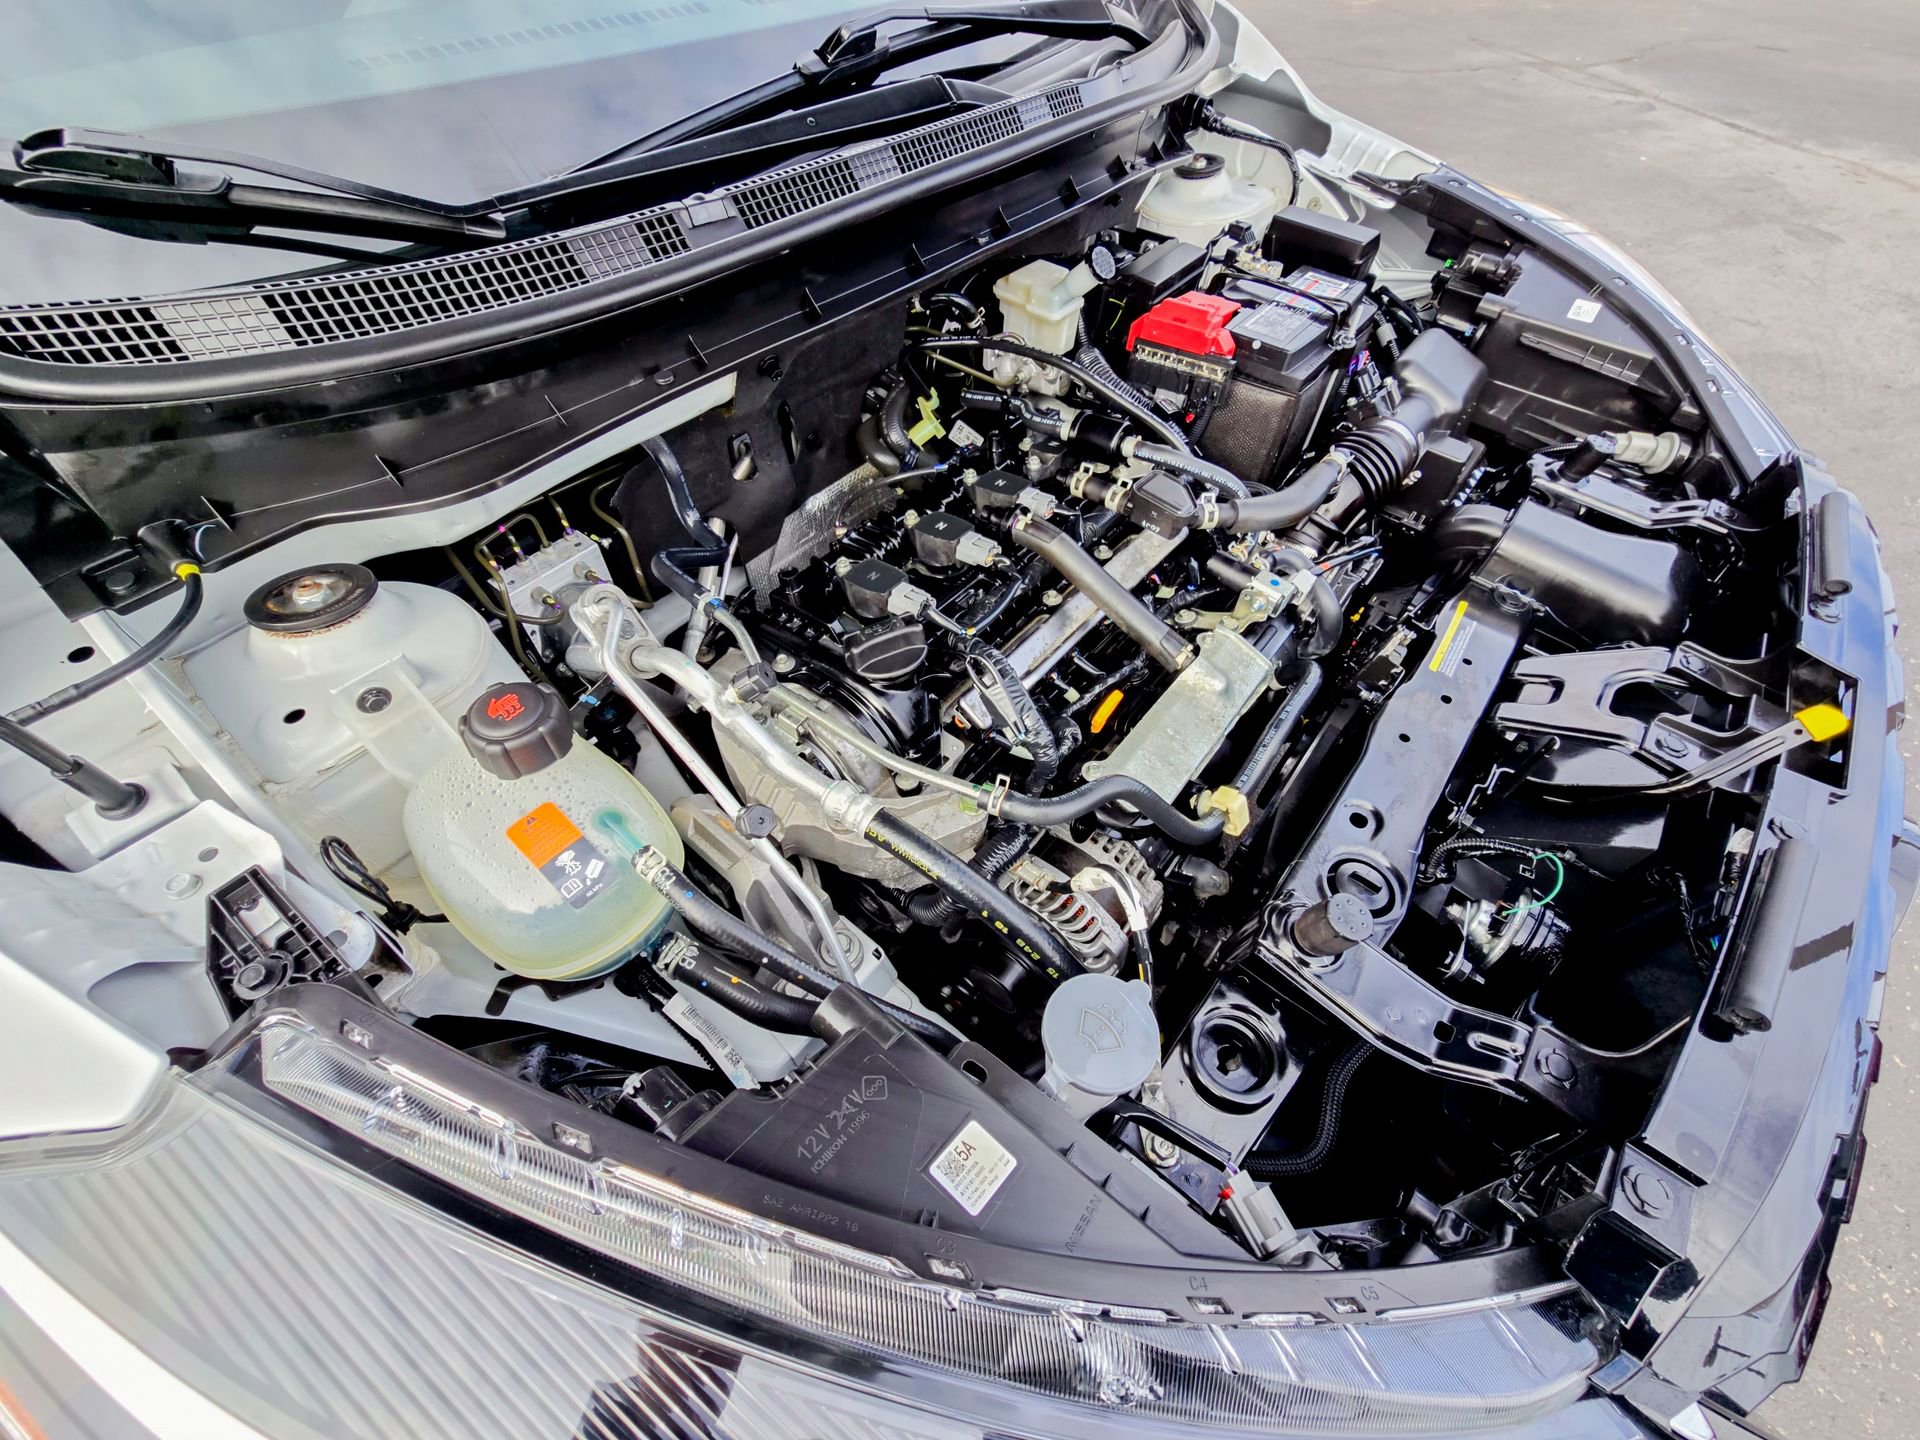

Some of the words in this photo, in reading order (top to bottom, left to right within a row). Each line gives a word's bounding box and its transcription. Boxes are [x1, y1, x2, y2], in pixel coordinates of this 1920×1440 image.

[954, 1140, 977, 1162] 5A
[1189, 1276, 1208, 1291] C4
[1361, 1286, 1379, 1301] C5
